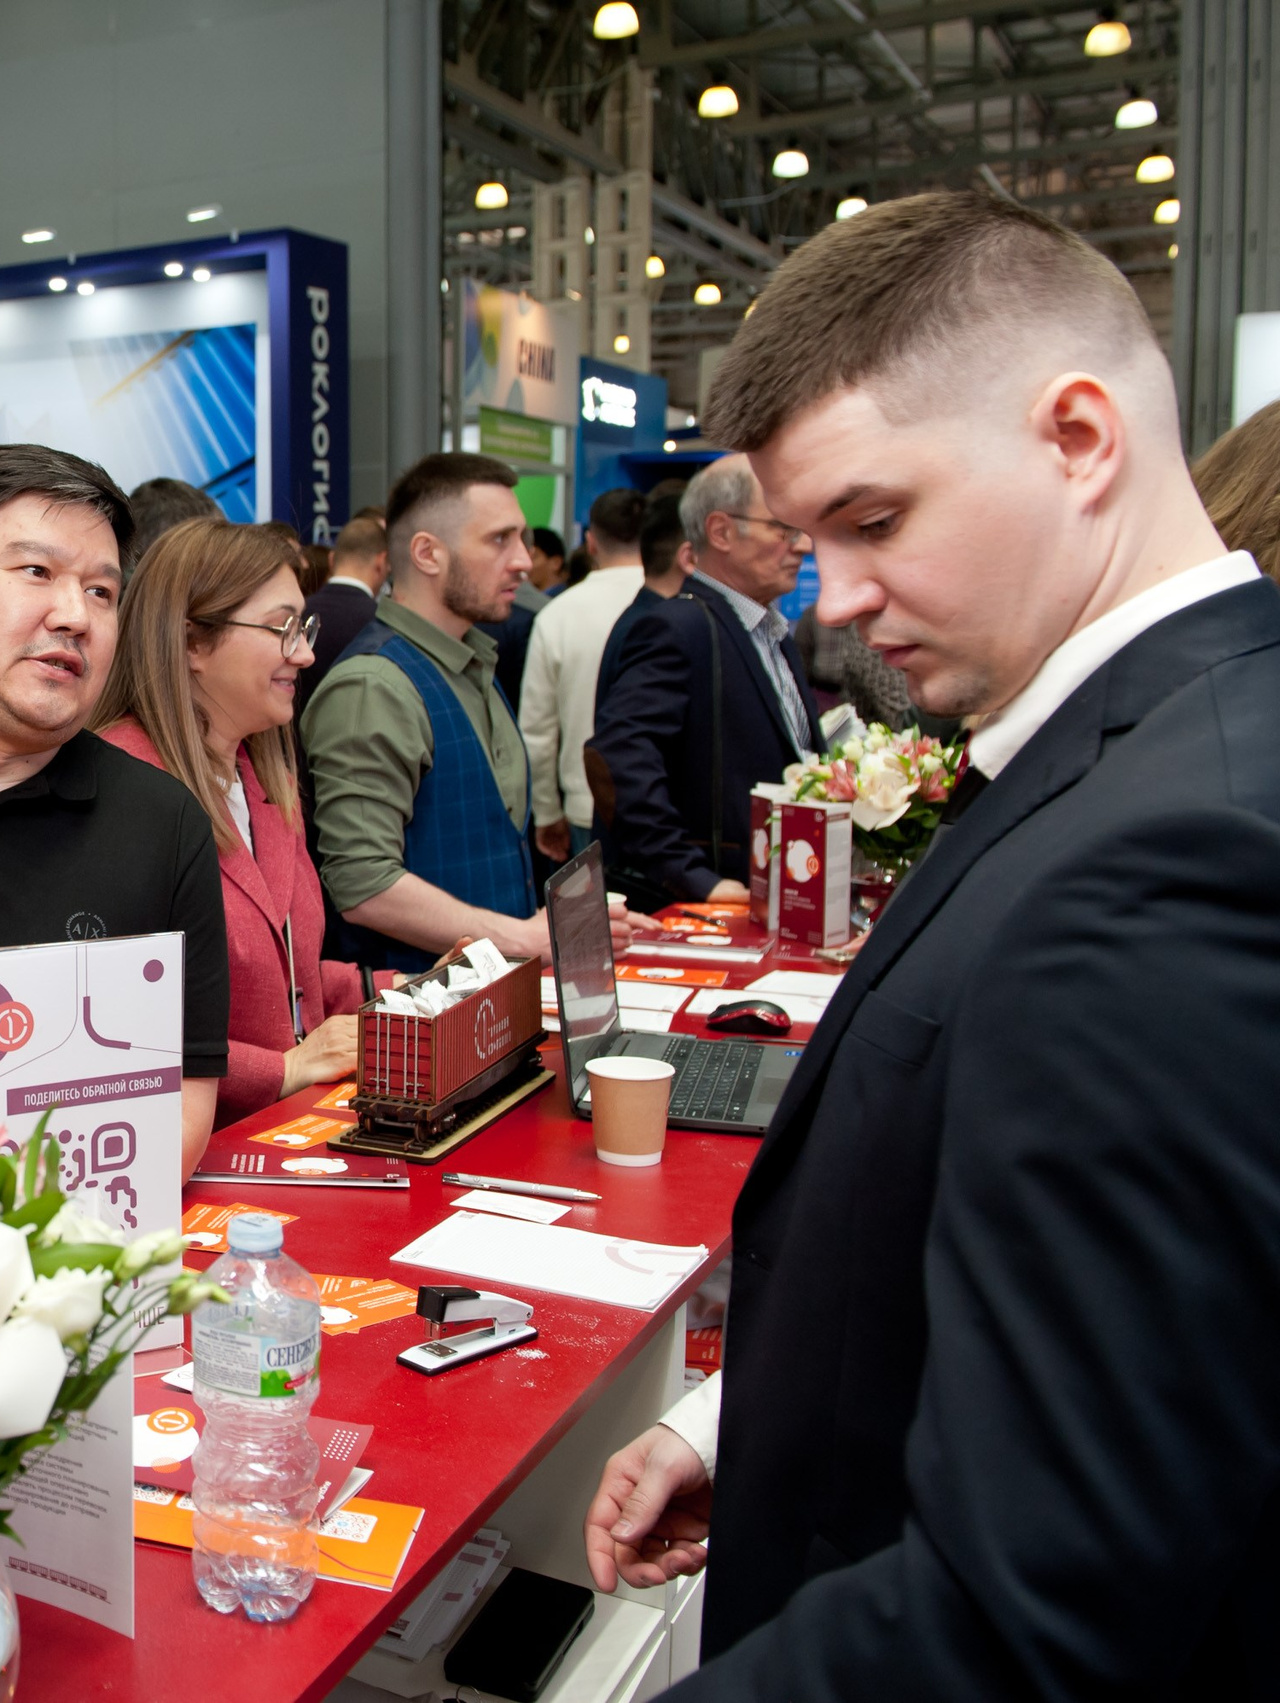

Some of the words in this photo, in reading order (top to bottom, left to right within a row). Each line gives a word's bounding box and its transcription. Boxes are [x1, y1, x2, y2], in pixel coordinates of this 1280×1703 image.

[24, 1088, 80, 1106] ПОДЕЛИТЕСЬ
[82, 1079, 126, 1098] ОБРАТНОЙ
[128, 1075, 163, 1091] СВЯЗЬЮ
[132, 1306, 165, 1329] ЧШЕ
